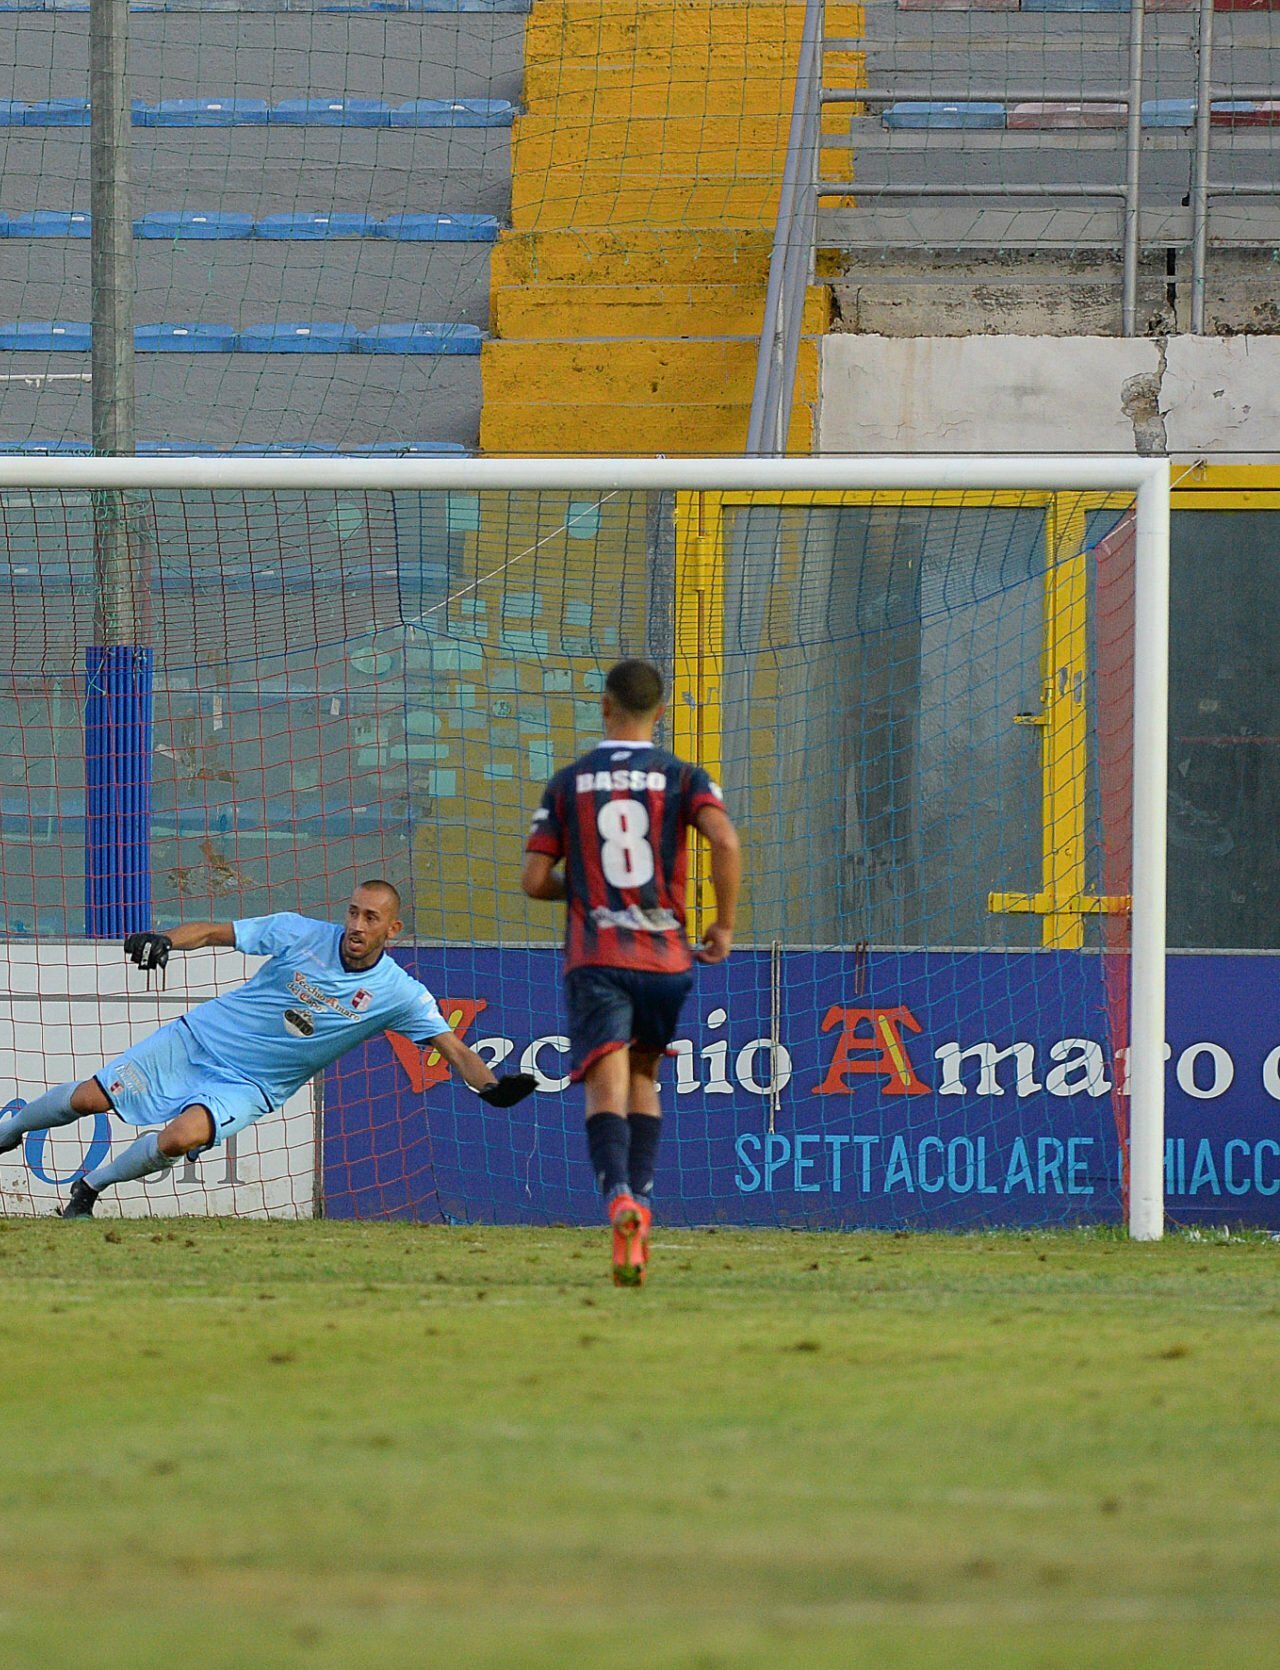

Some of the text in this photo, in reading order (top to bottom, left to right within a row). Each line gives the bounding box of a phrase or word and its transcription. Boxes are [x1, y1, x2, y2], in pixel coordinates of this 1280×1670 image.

[576, 770, 667, 793] BASSO
[597, 799, 655, 889] 8
[220, 1115, 237, 1128] 1
[734, 1132, 1095, 1195] SPETTACOLARE
